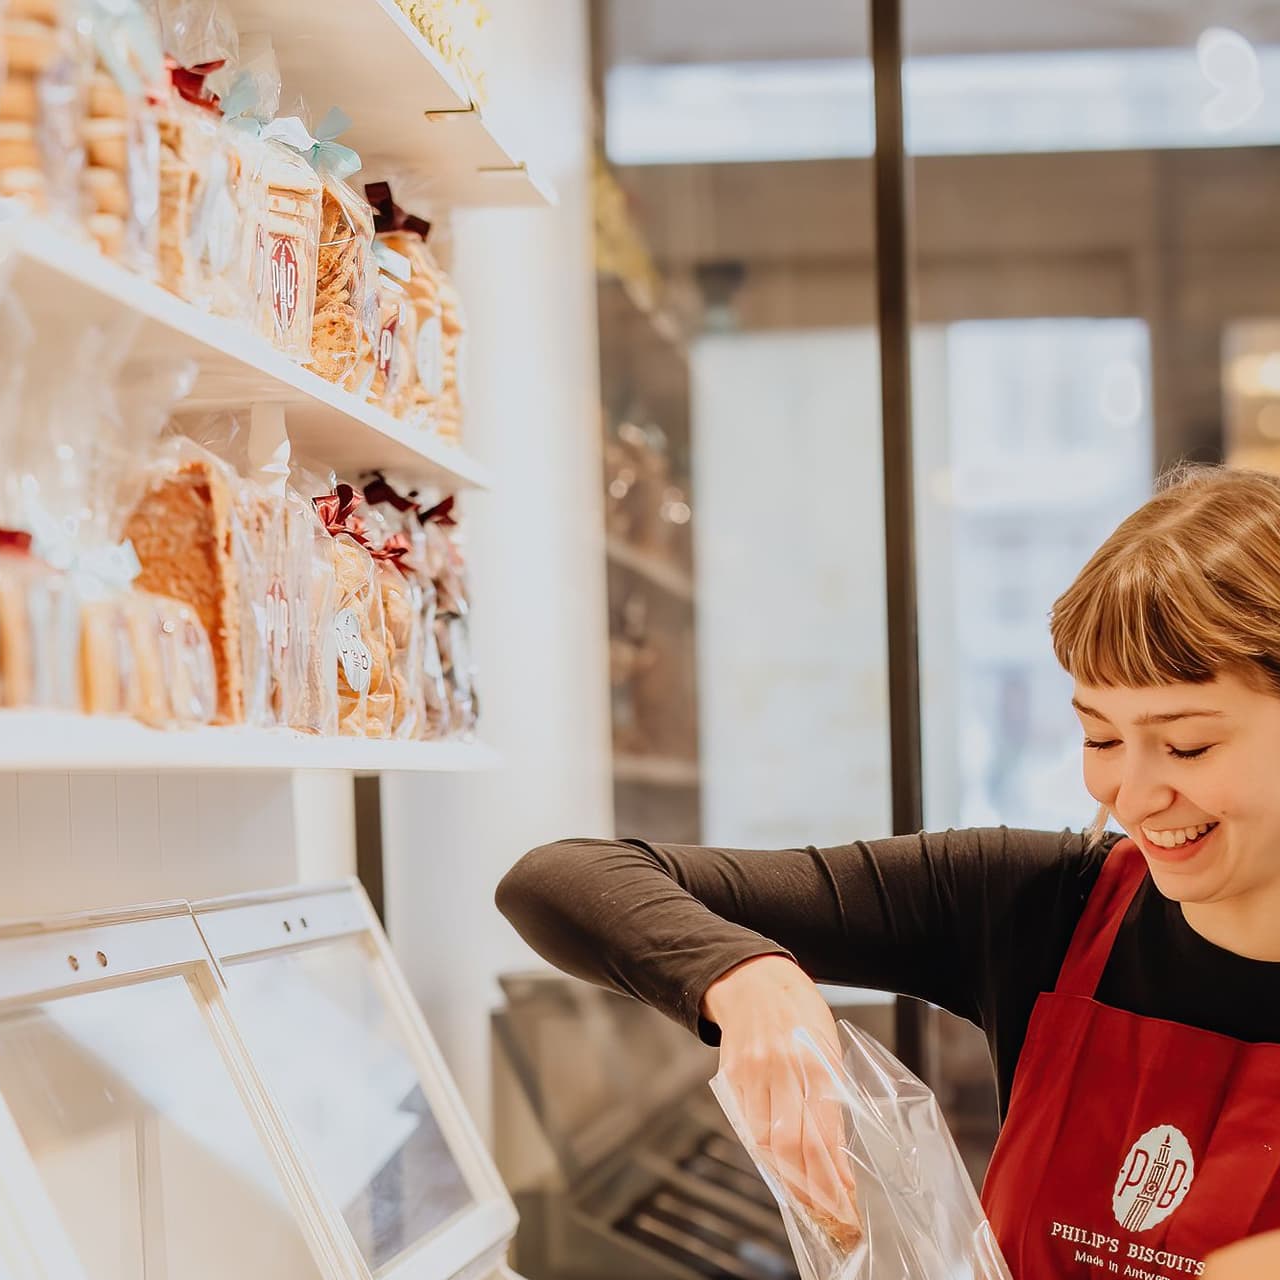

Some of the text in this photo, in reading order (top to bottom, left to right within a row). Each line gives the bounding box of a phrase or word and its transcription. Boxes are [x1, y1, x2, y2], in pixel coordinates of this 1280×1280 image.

[1051, 1222, 1206, 1276] PHILIP'S BISCUITS
[1074, 1250, 1104, 1267] Made
